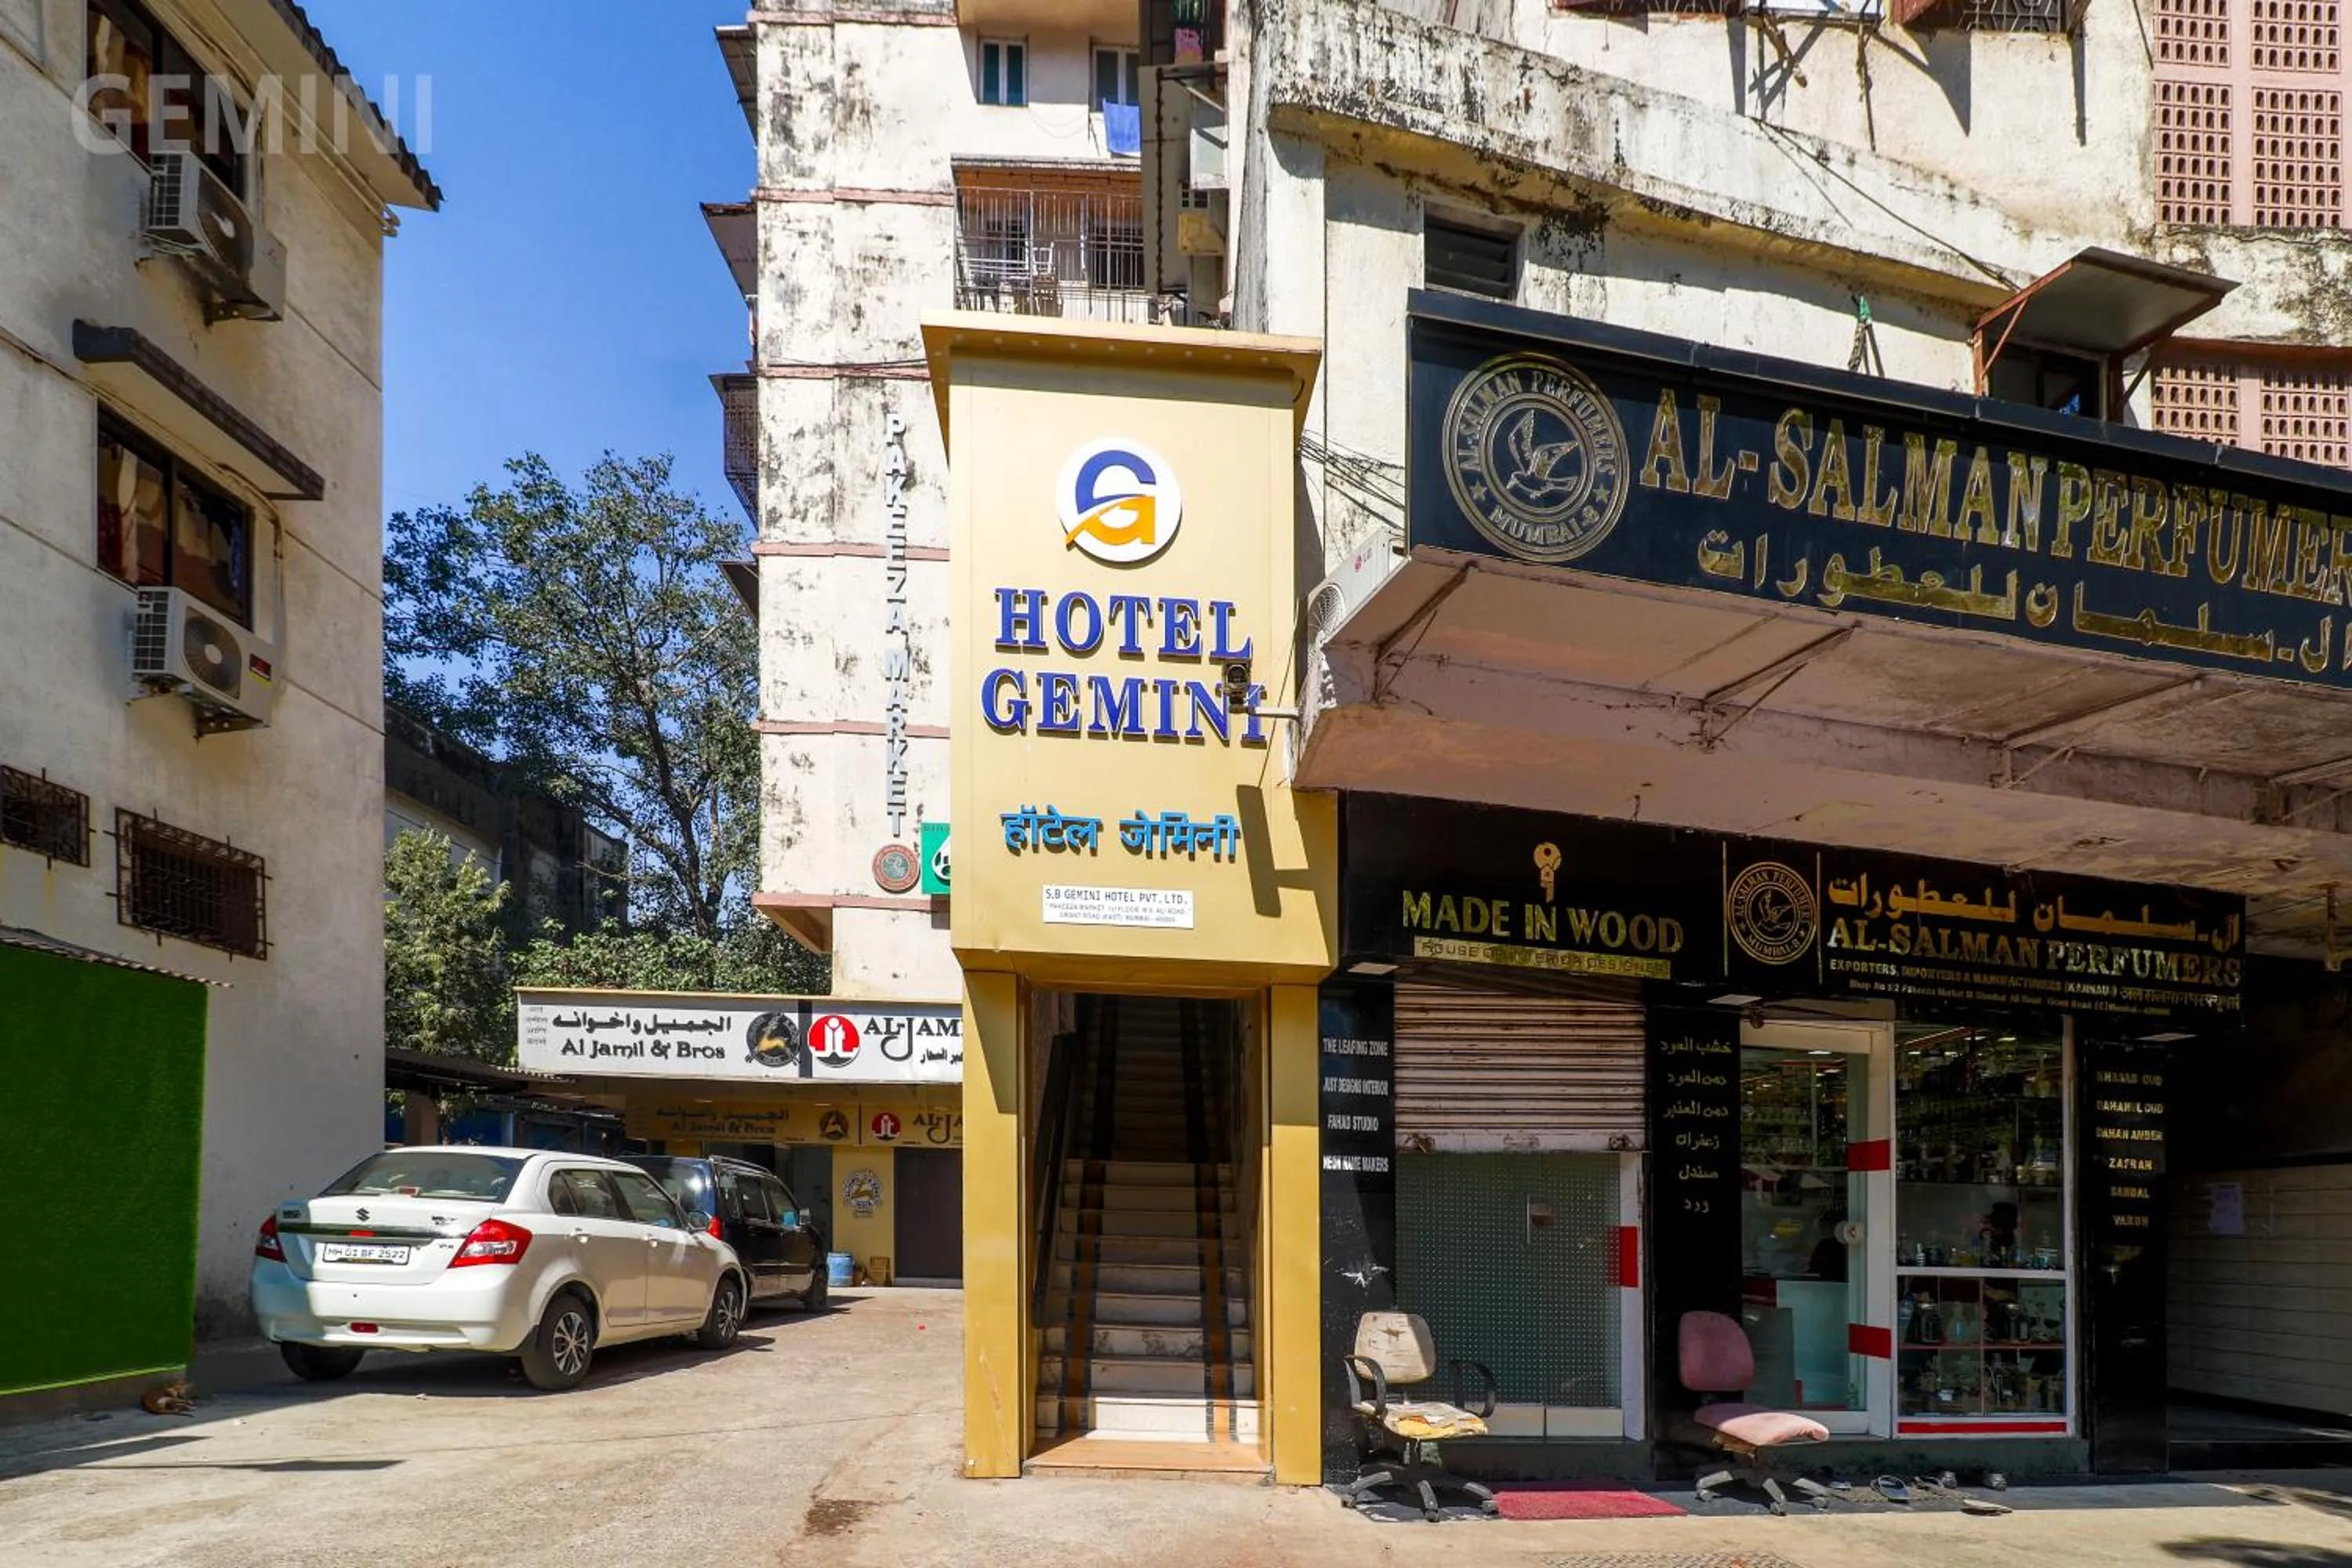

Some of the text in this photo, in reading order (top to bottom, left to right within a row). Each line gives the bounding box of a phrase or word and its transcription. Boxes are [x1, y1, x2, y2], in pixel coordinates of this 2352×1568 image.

[1639, 387, 2048, 553] AL-SALMAN
[886, 413, 908, 633] PAKEEZA
[994, 587, 1253, 659] HOTEL
[884, 647, 909, 837] MARKET
[981, 667, 1267, 746] GEMINI
[1064, 889, 1101, 901] GEMINI
[1105, 892, 1136, 902] HOTEL
[1402, 890, 1684, 954] MADE IN WOOD
[1826, 916, 2241, 988] AL-SALMAN PERFUMERS
[561, 1038, 585, 1056] Al
[590, 1039, 644, 1059] Jamil
[650, 1040, 671, 1059] &
[677, 1040, 726, 1059] Bros
[863, 1017, 964, 1062] AL-JAM
[1368, 1040, 1388, 1057] ZONE
